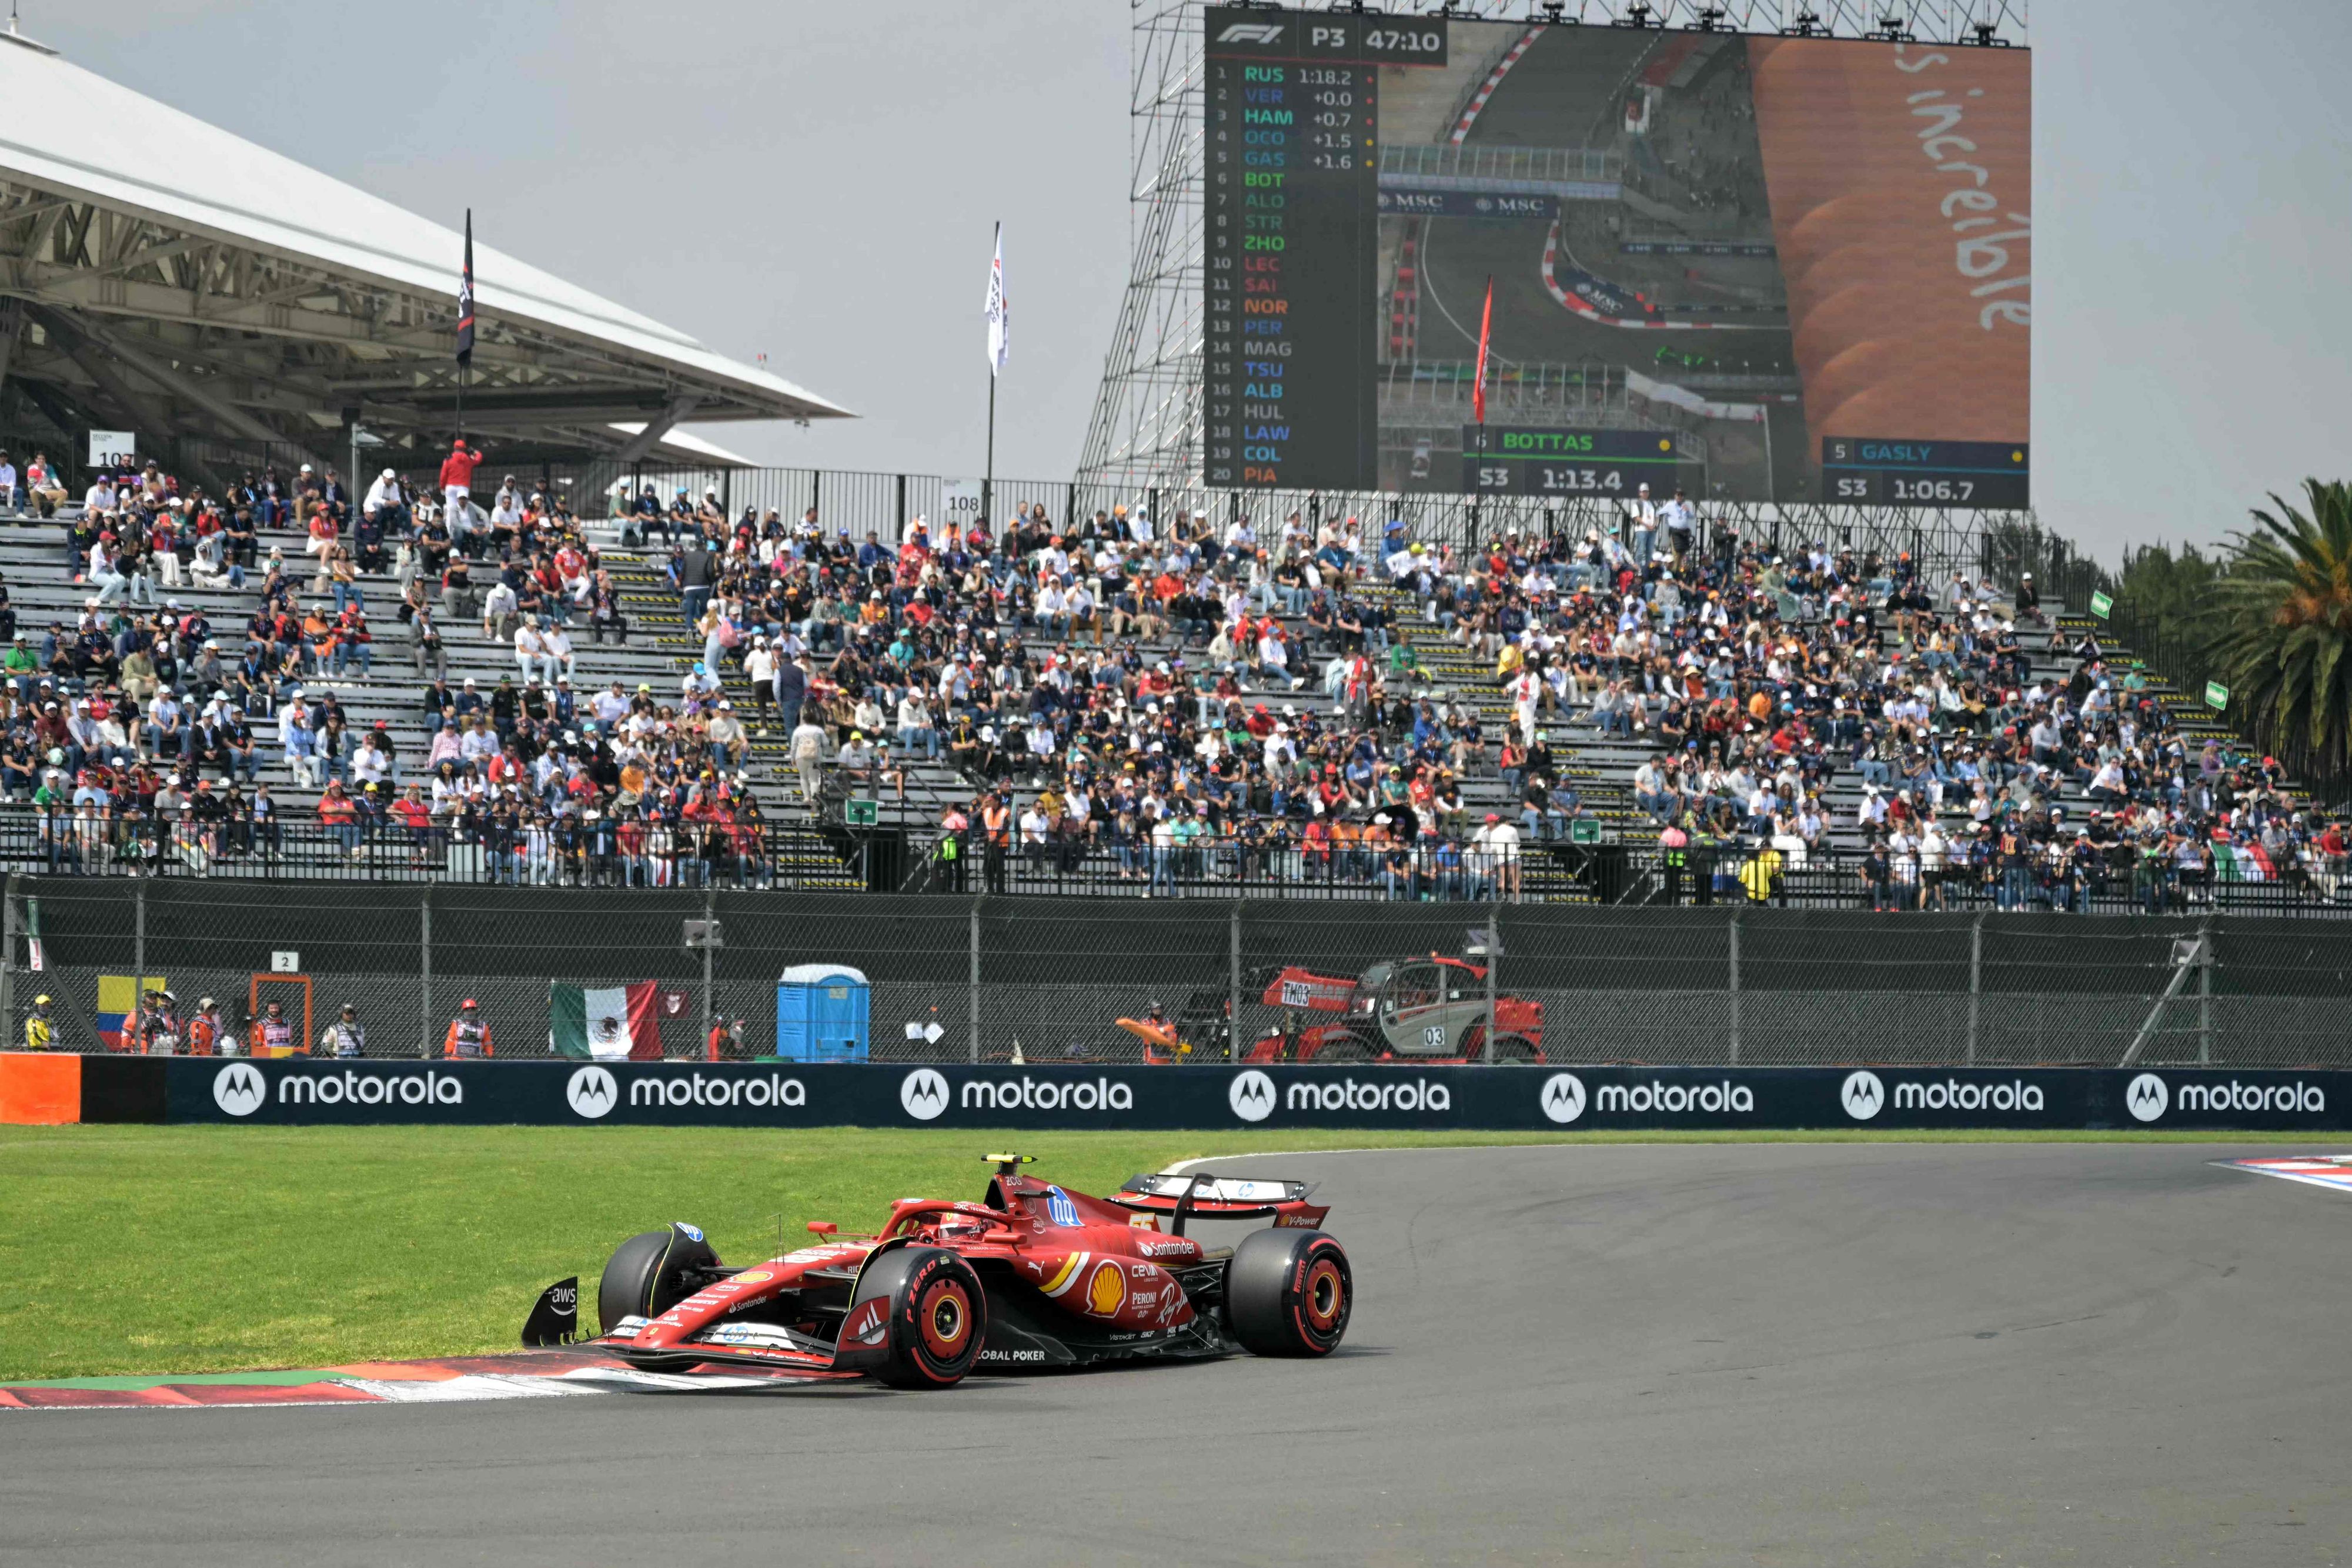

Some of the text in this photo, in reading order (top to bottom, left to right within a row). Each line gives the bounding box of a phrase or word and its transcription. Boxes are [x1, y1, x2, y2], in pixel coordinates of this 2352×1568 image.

[1312, 27, 1345, 47] P3
[1366, 31, 1440, 51] 47:10
[1217, 66, 1351, 85] 1 RUS 1:18.2
[1217, 88, 1351, 106] 2 VER +0.0
[1217, 109, 1351, 127] 3 HAM +0.7
[1217, 131, 1351, 148] 4 OCO +1.5
[1217, 152, 1351, 169] 5 GAS +1.6
[1217, 173, 1285, 188] 6 BOT
[1217, 193, 1284, 208] 7 ALO
[1396, 193, 1443, 208] MSC
[1498, 198, 1544, 210] MSC
[1217, 215, 1283, 230] 8 STR
[1217, 235, 1285, 251] 9 ZHO
[1213, 257, 1280, 272] 10 LEC
[1213, 278, 1277, 292] 11 SAI
[1213, 298, 1288, 314] 12 NOR
[1213, 319, 1282, 335] 13 PER
[1213, 341, 1292, 356] 14 MAG
[1213, 362, 1283, 377] 15 TSU
[1213, 383, 1283, 398] 16 ALB
[1213, 404, 1284, 419] 17 HUL
[1213, 425, 1289, 440] 18 LAW
[1504, 433, 1593, 451] BOTTAS
[99, 452, 134, 468] 10
[1213, 446, 1281, 462] 19 COL
[1835, 444, 1932, 461] 5 GASLY
[1212, 467, 1277, 483] 20 PIA
[1543, 470, 1623, 491] 1:13.4
[1838, 479, 1974, 501] S3 1:06.7
[949, 497, 978, 511] 108
[282, 957, 289, 967] 2
[1284, 983, 1309, 1005] TH03
[1425, 1028, 1444, 1045] 03
[279, 1070, 462, 1104] motorola
[631, 1072, 805, 1106] motorola
[963, 1076, 1132, 1109] motorola
[1287, 1078, 1450, 1110] motorola
[1895, 1079, 2043, 1110] motorola
[1598, 1080, 1753, 1111] motorola
[2179, 1081, 2324, 1111] motorola
[970, 1207, 997, 1216] TECHNOLOGY
[1289, 1215, 1319, 1225] V-Power
[1150, 1240, 1194, 1256] Santander
[552, 1288, 576, 1303] aws
[907, 1259, 936, 1323] P ZERO
[1132, 1292, 1157, 1305] PERONI
[737, 1296, 767, 1311] Santander
[1013, 1350, 1045, 1361] POKER
